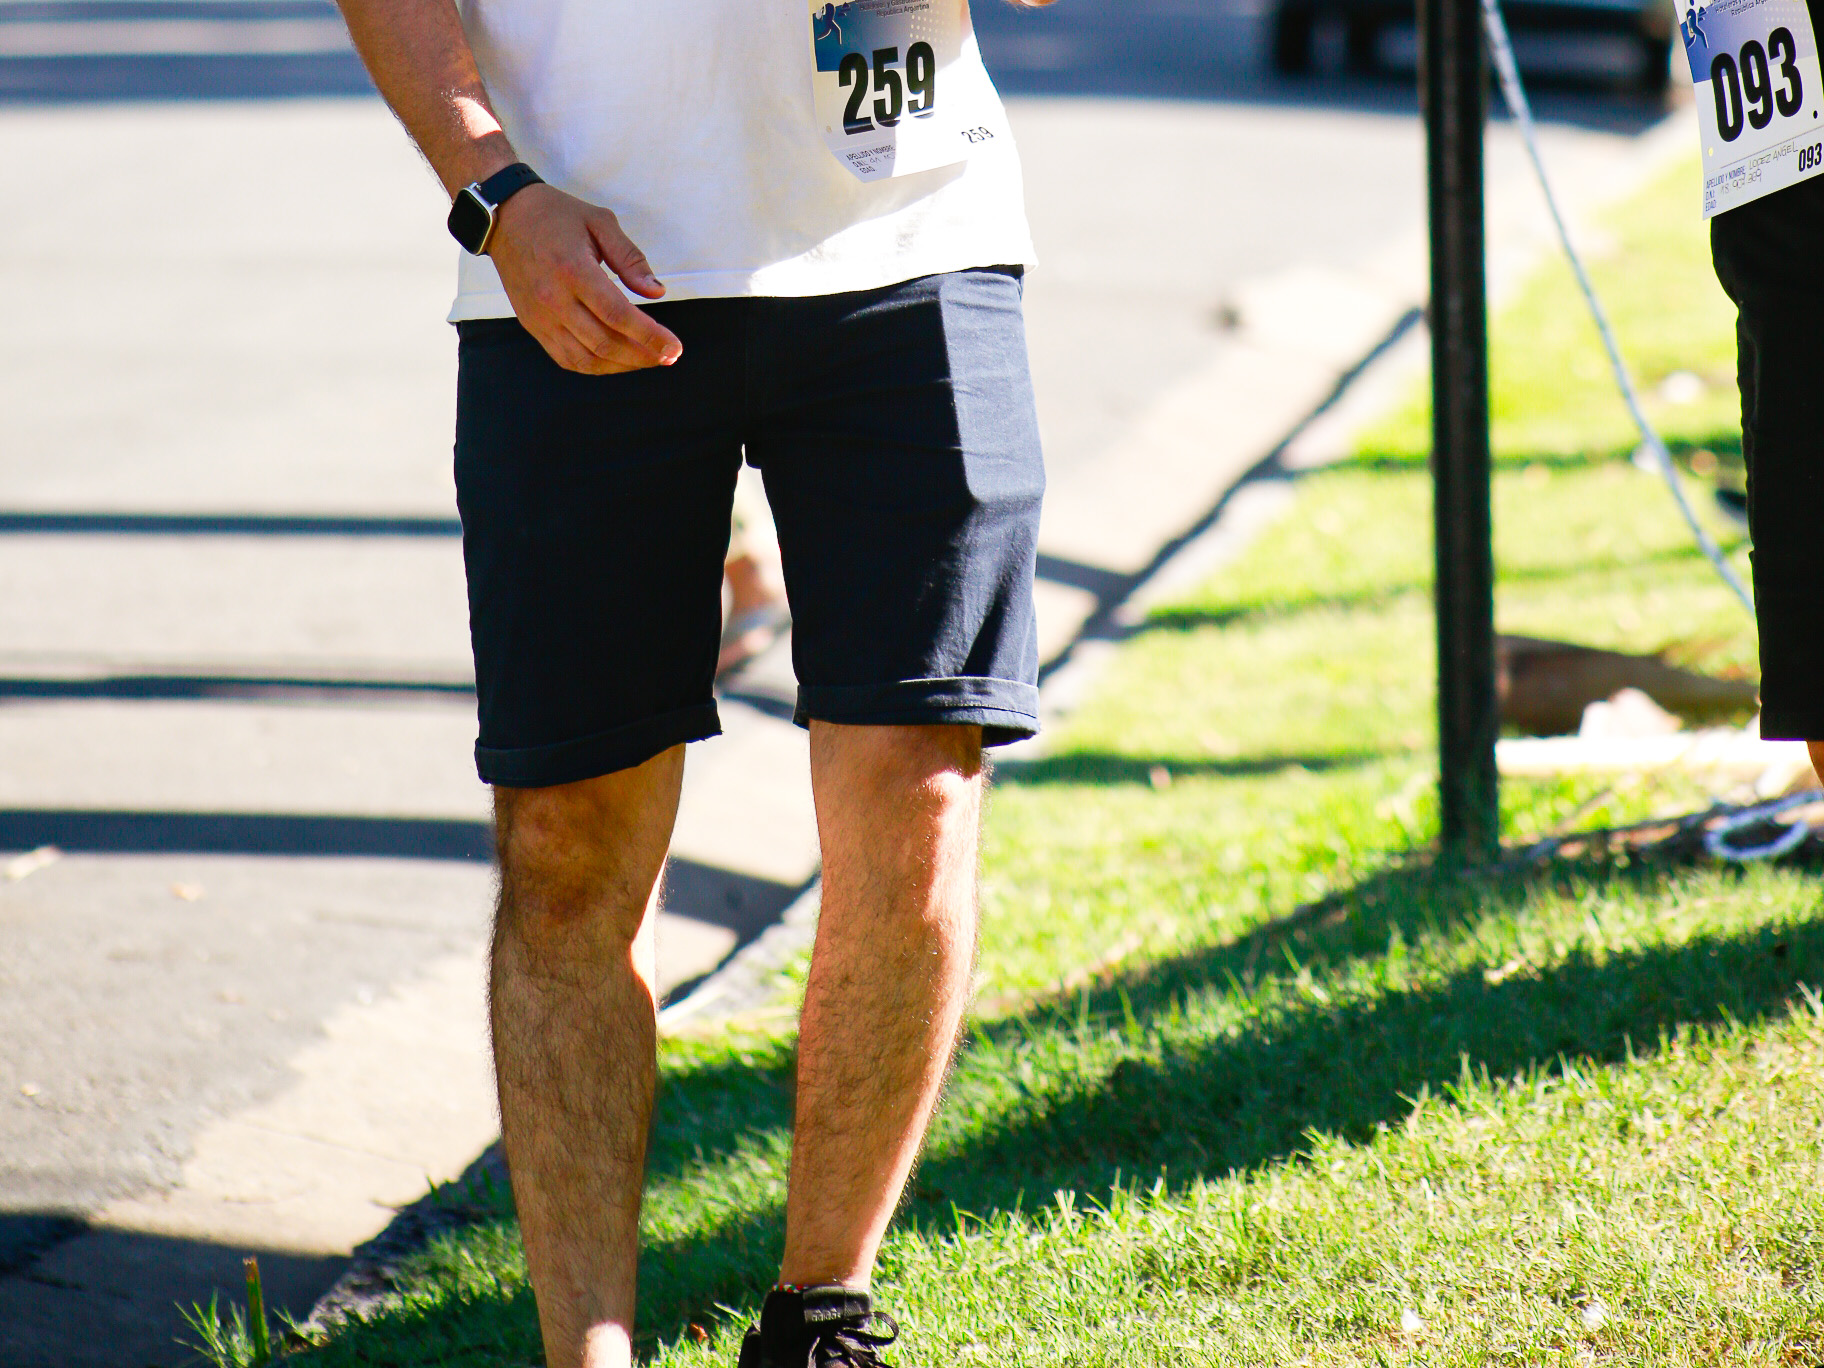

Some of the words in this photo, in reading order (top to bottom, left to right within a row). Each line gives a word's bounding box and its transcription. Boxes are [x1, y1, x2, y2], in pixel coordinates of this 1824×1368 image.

[838, 41, 936, 136] 259
[1710, 26, 1804, 143] 093
[961, 126, 995, 144] 259
[1773, 141, 1799, 160] ANGEL
[1798, 142, 1823, 173] 093
